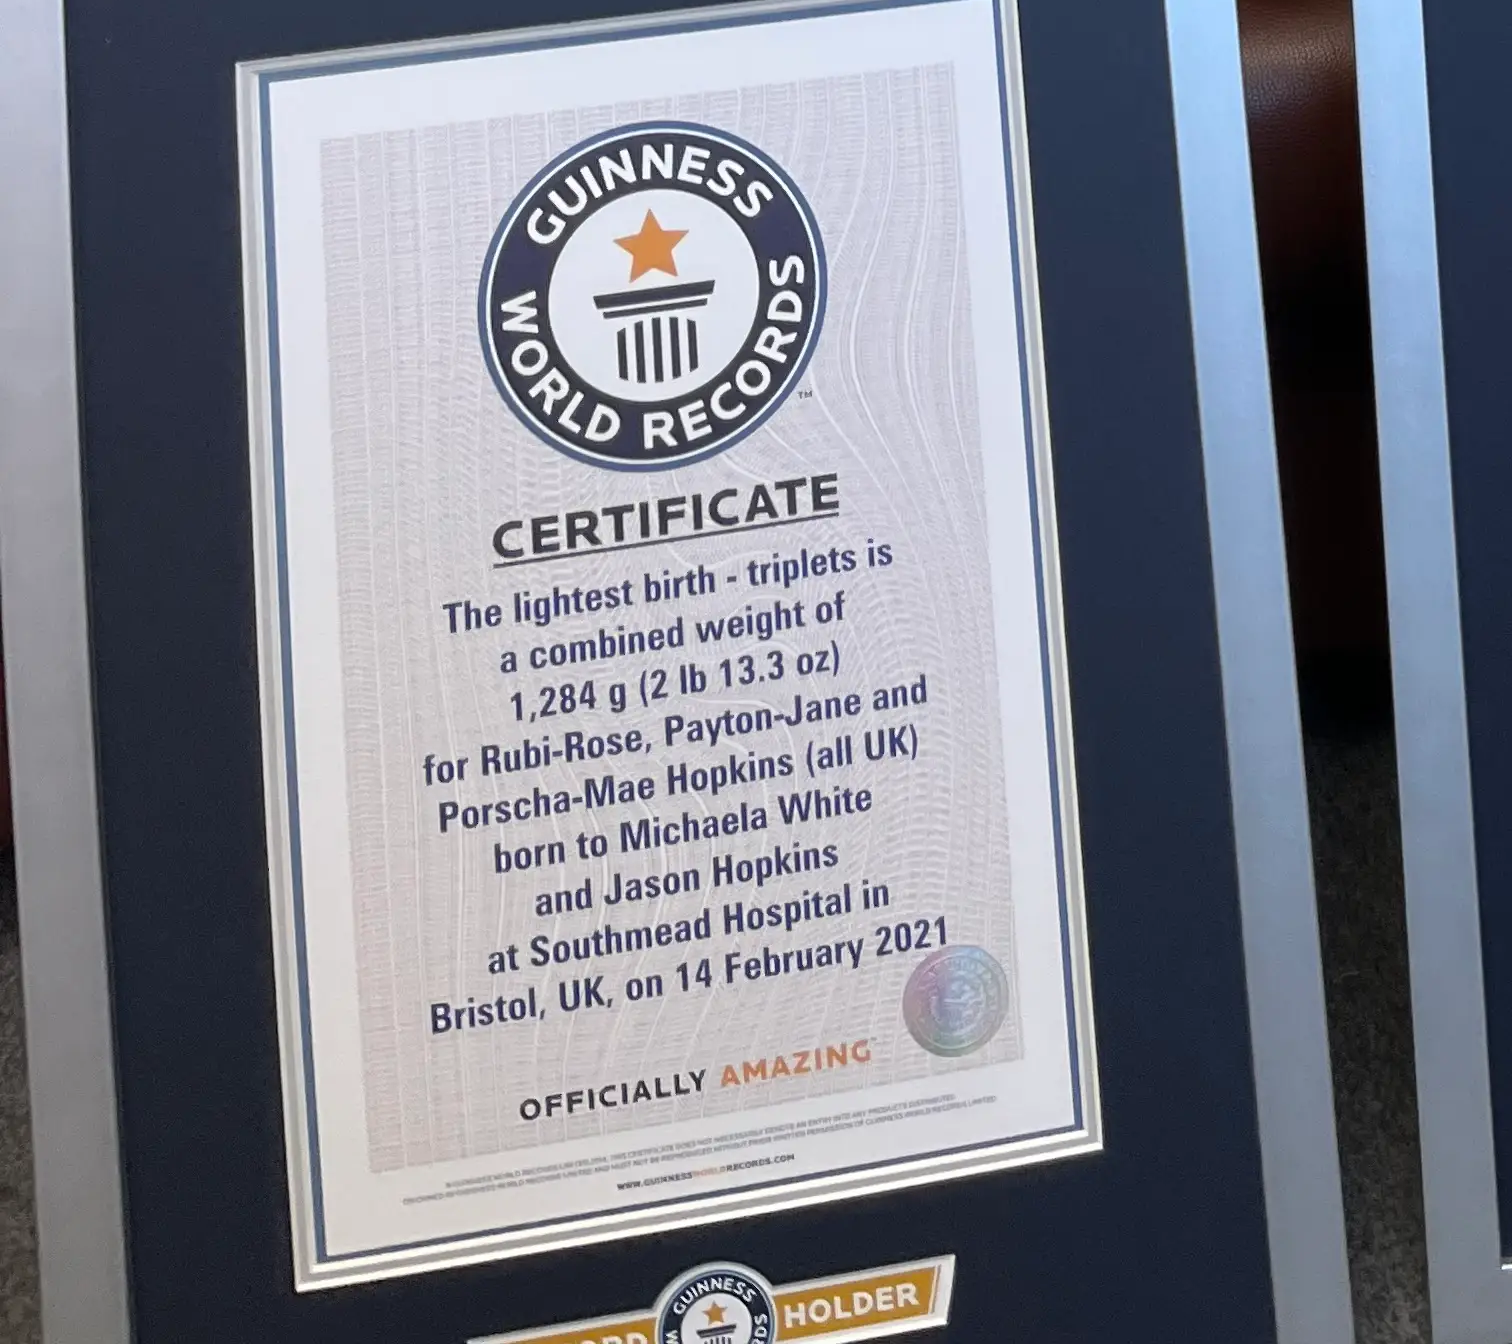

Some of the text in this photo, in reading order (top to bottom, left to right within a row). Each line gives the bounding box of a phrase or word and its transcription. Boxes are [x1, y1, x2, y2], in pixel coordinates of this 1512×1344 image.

[526, 143, 774, 244] GUINNESS
[500, 254, 805, 450] WORLD RECORDS
[492, 472, 840, 560] CERTIFICATE
[442, 600, 503, 634] The
[513, 579, 634, 627] lightest
[643, 564, 716, 604] birth
[746, 547, 858, 589] triplets
[867, 537, 894, 568] is
[500, 590, 846, 674] a combined weight of
[510, 639, 841, 723] 1,284 g (2 lb 13.3 oz)
[422, 673, 928, 787] for Rubi-Rose, Payton-Jane and
[437, 723, 919, 834] Porscha-Mae Hopkins (all UK)
[493, 785, 873, 874] born to Michaela White
[535, 841, 839, 917] and Jason Hopkins
[488, 879, 890, 976] at Southmead Hospital in
[429, 915, 947, 1035] Bristol, UK, on 14 February 2021
[519, 1040, 871, 1122] OFFICIALLY AMAZING
[673, 1277, 757, 1315] GUINNESS
[784, 1282, 919, 1329] HOLDER
